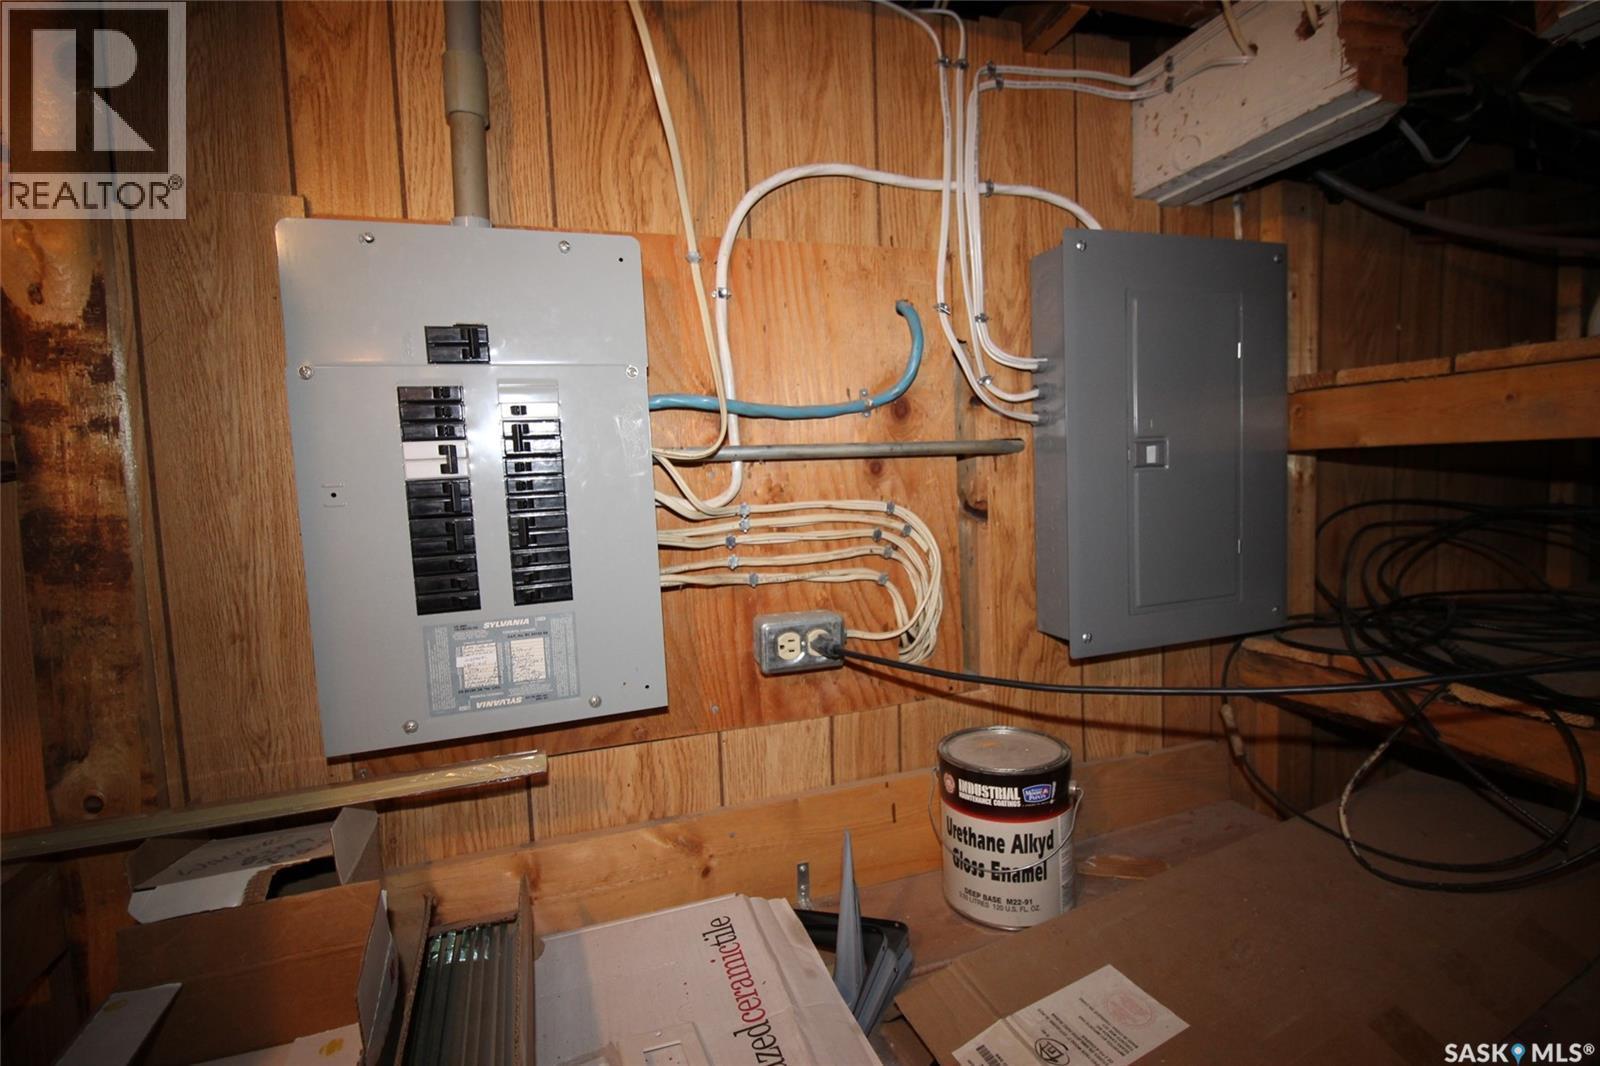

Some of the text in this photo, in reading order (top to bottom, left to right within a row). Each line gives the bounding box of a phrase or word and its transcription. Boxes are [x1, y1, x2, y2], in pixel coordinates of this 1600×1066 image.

[483, 617, 530, 630] SYLVANIA
[476, 696, 523, 710] SYLVANIA
[958, 778, 1021, 801] INDUSTRIAL
[993, 799, 1022, 808] COATINGS
[946, 816, 1054, 859] Urethane Alkyd
[952, 847, 1048, 883] Gloss Enamel
[964, 887, 982, 898] DEEP
[982, 894, 1002, 904] BASE
